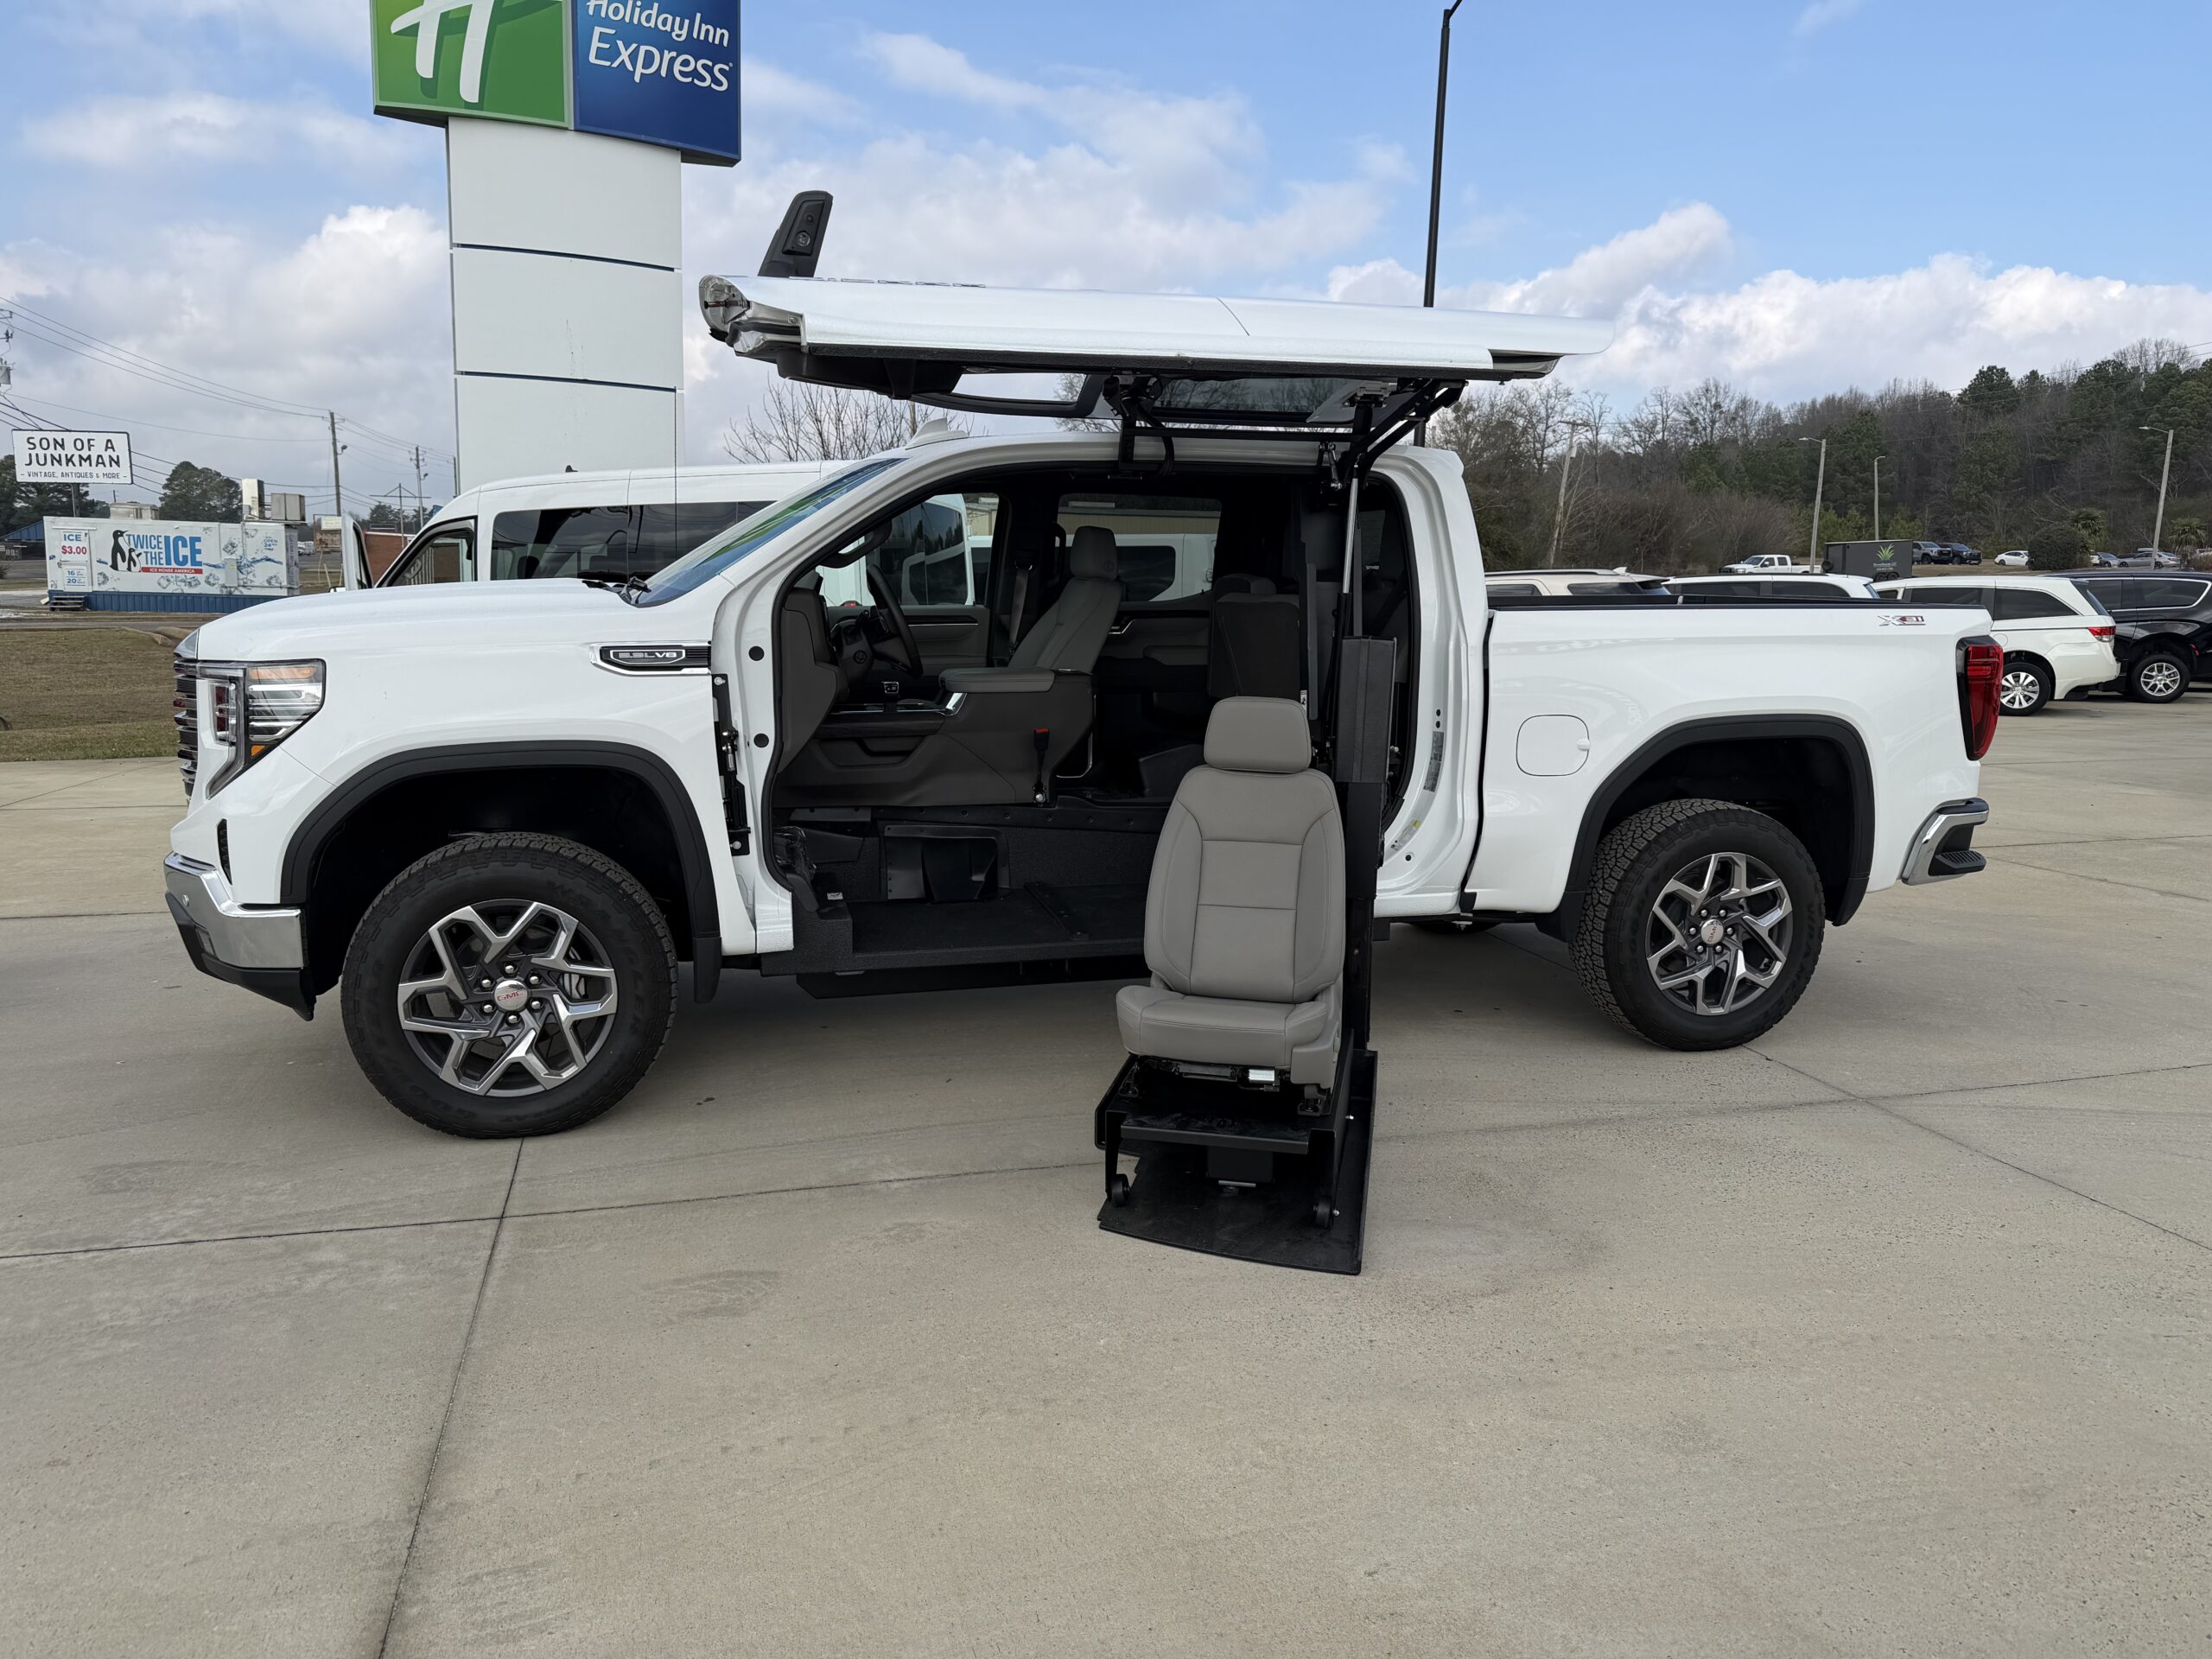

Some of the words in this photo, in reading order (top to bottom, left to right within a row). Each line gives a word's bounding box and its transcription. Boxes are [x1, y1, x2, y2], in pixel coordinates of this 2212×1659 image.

[692, 12, 729, 48] Inn
[588, 26, 730, 92] Express
[26, 436, 65, 451] SON
[73, 437, 95, 452] OF
[105, 439, 116, 452] A
[25, 453, 121, 467] JUNKMAN
[63, 533, 82, 542] ICE
[125, 534, 162, 550] TWICE
[61, 544, 87, 555] $3.00
[164, 535, 203, 567] ICE
[143, 550, 164, 565] THE
[497, 990, 524, 1001] GMC
